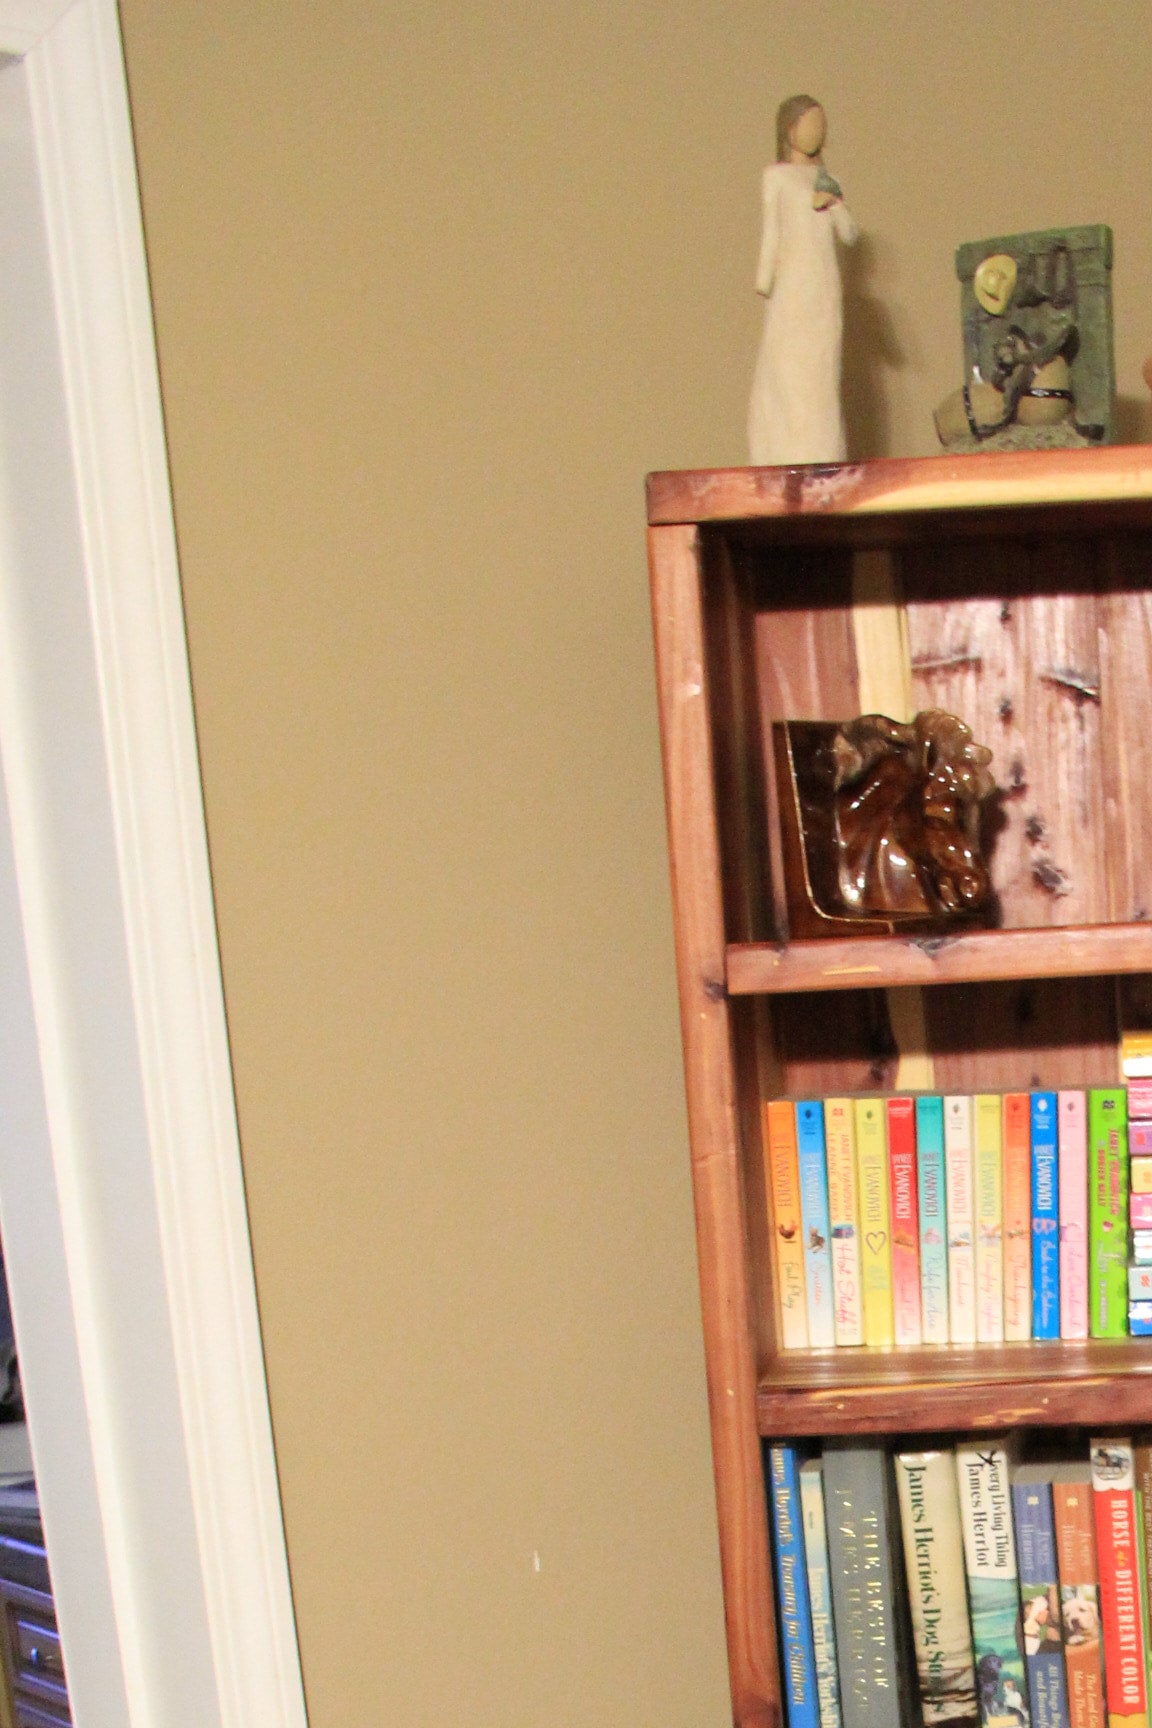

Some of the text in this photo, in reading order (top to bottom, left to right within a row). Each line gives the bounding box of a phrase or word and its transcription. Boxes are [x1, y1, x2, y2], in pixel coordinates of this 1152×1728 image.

[894, 1165, 911, 1219] EVANOVICH
[923, 1163, 939, 1217] EVANOVICH
[1036, 1155, 1054, 1210] EVANOVICH
[965, 1461, 992, 1567] James Herriot
[989, 1494, 1010, 1568] Living Thing
[903, 1463, 944, 1646] James Herriot's Dog
[1109, 1499, 1141, 1705] HORSE DIFFERENT COLOR
[1036, 1670, 1047, 1689] and
[1049, 1680, 1061, 1713] Things
[1085, 1673, 1097, 1691] The
[1086, 1691, 1098, 1713] Lord
